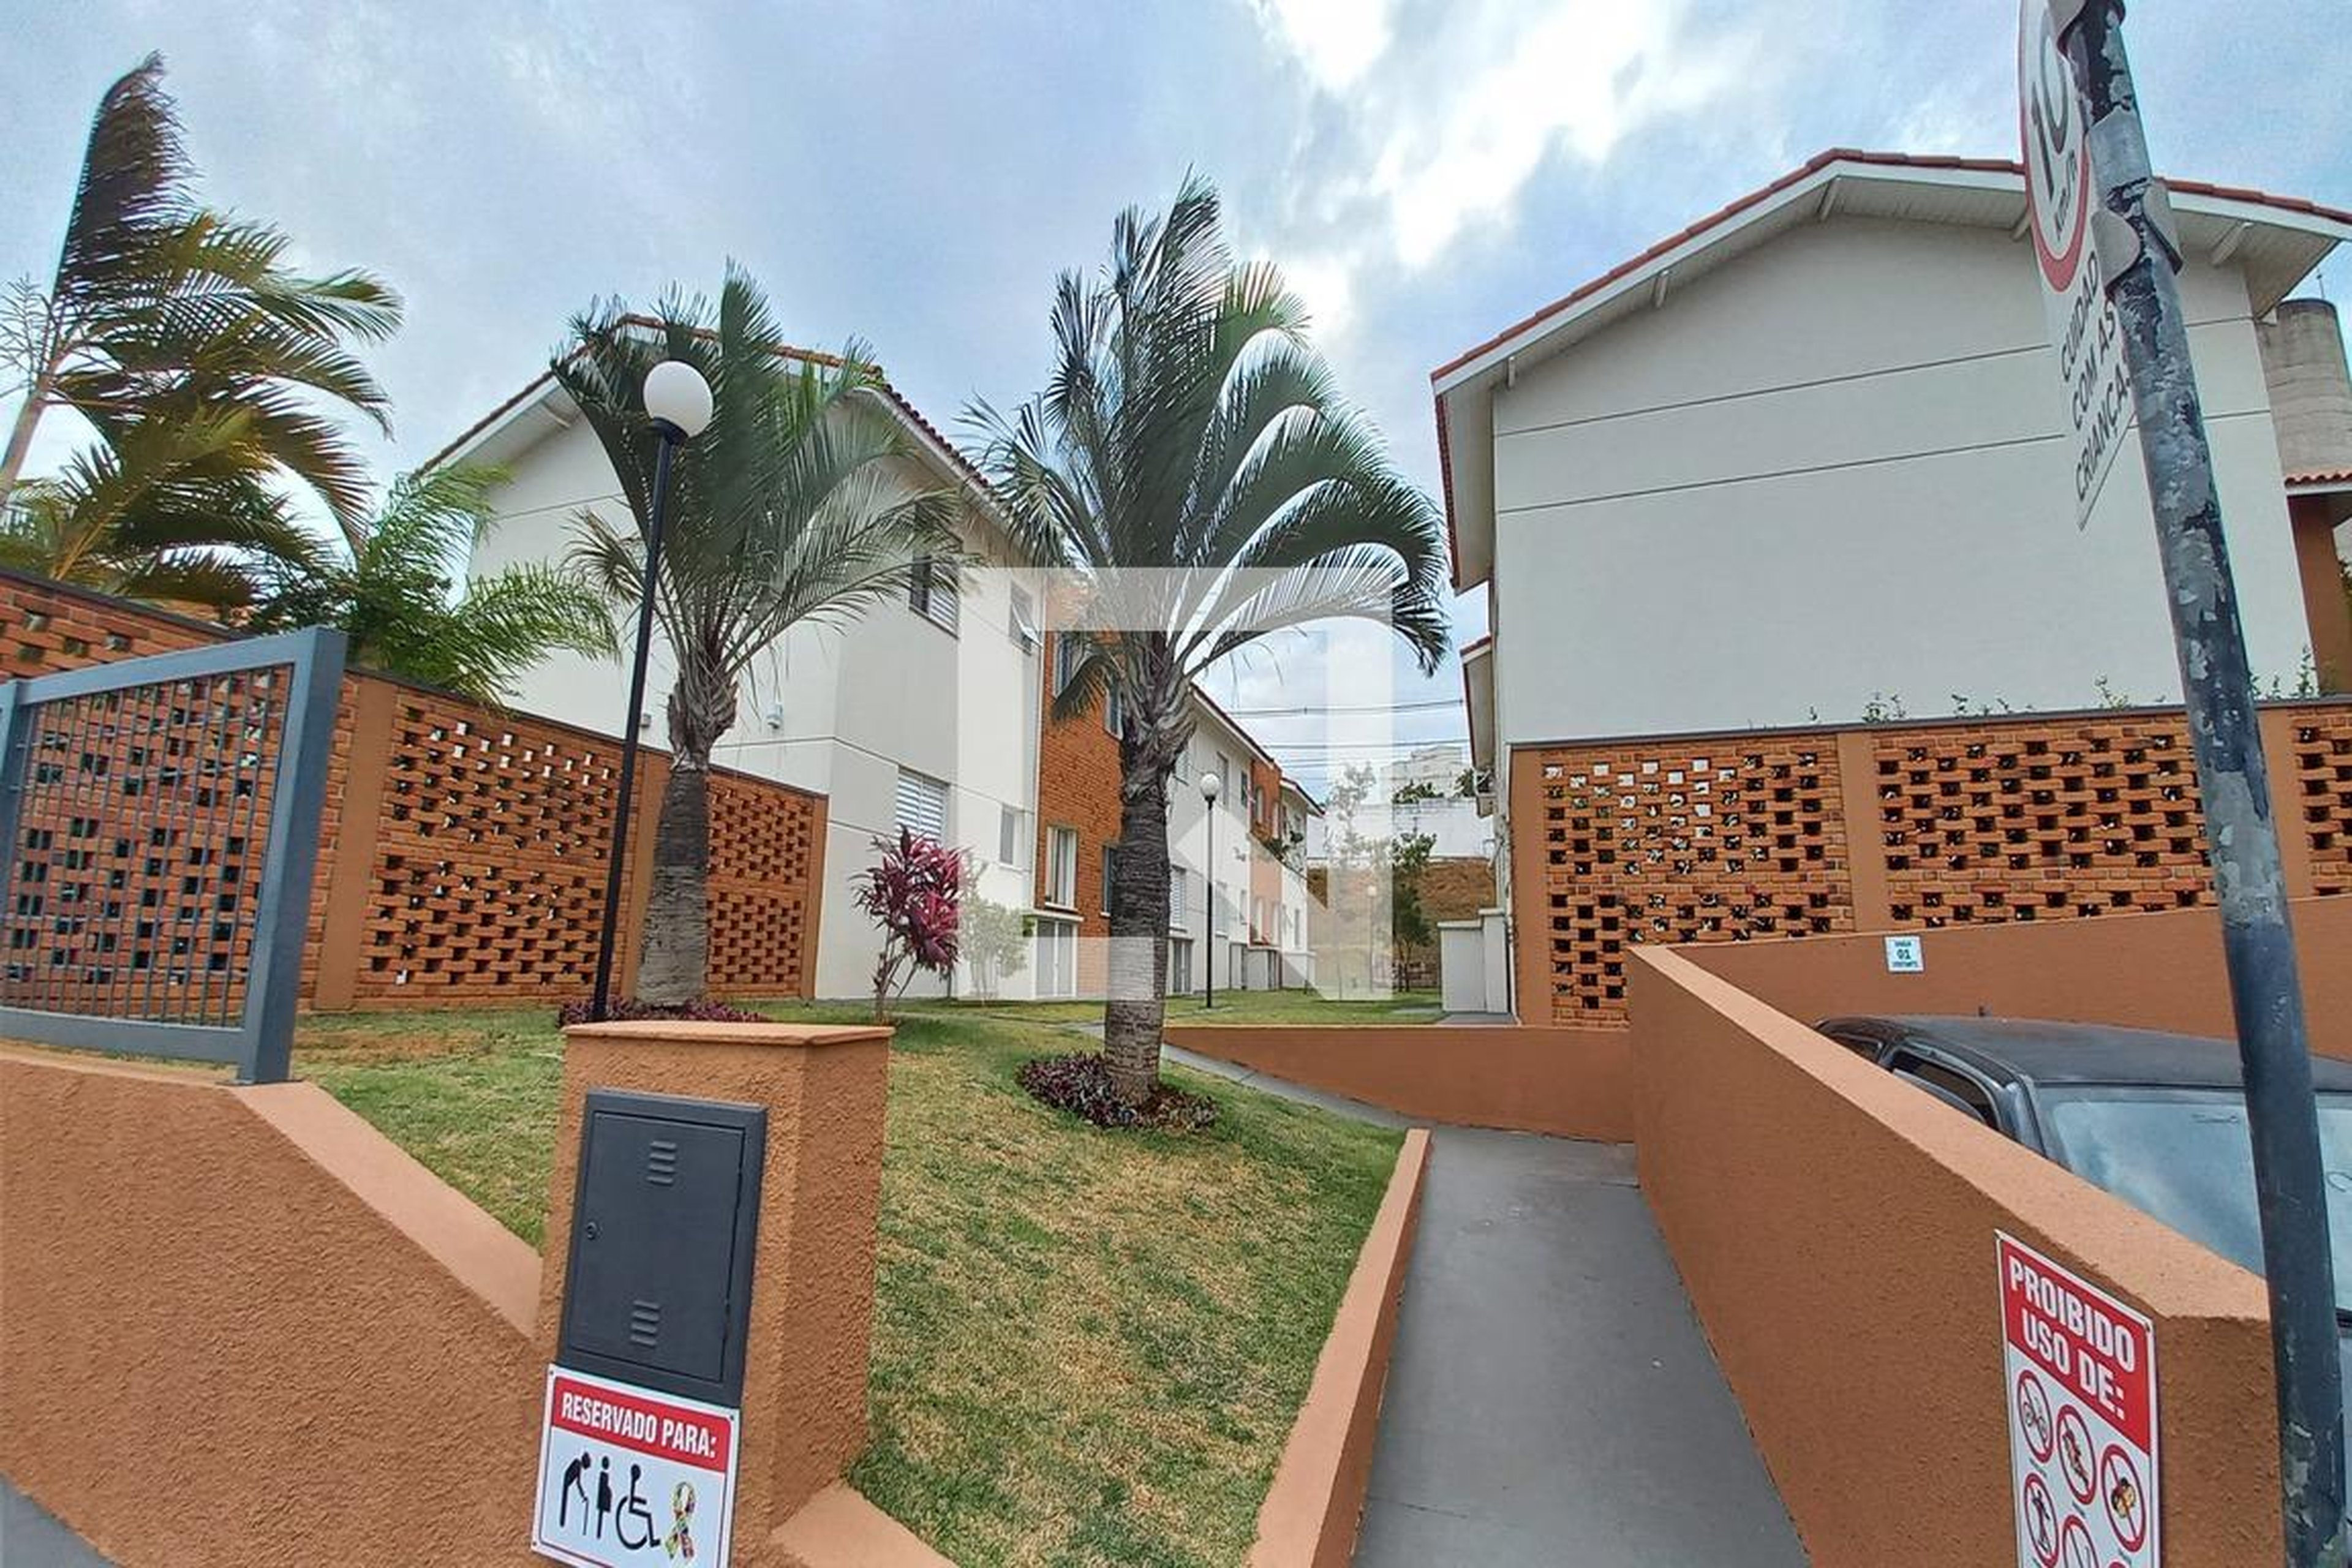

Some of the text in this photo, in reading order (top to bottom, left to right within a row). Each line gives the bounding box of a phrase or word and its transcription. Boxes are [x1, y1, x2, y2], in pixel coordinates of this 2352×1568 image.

[2062, 250, 2098, 383] CUIDAD
[2073, 297, 2115, 431] COM AS
[2076, 364, 2130, 502] CRIANÇA
[2008, 1254, 2136, 1373] PROIBIDO
[2022, 1309, 2125, 1421] USO DE:
[561, 1392, 717, 1459] RESERVADO PARA:
